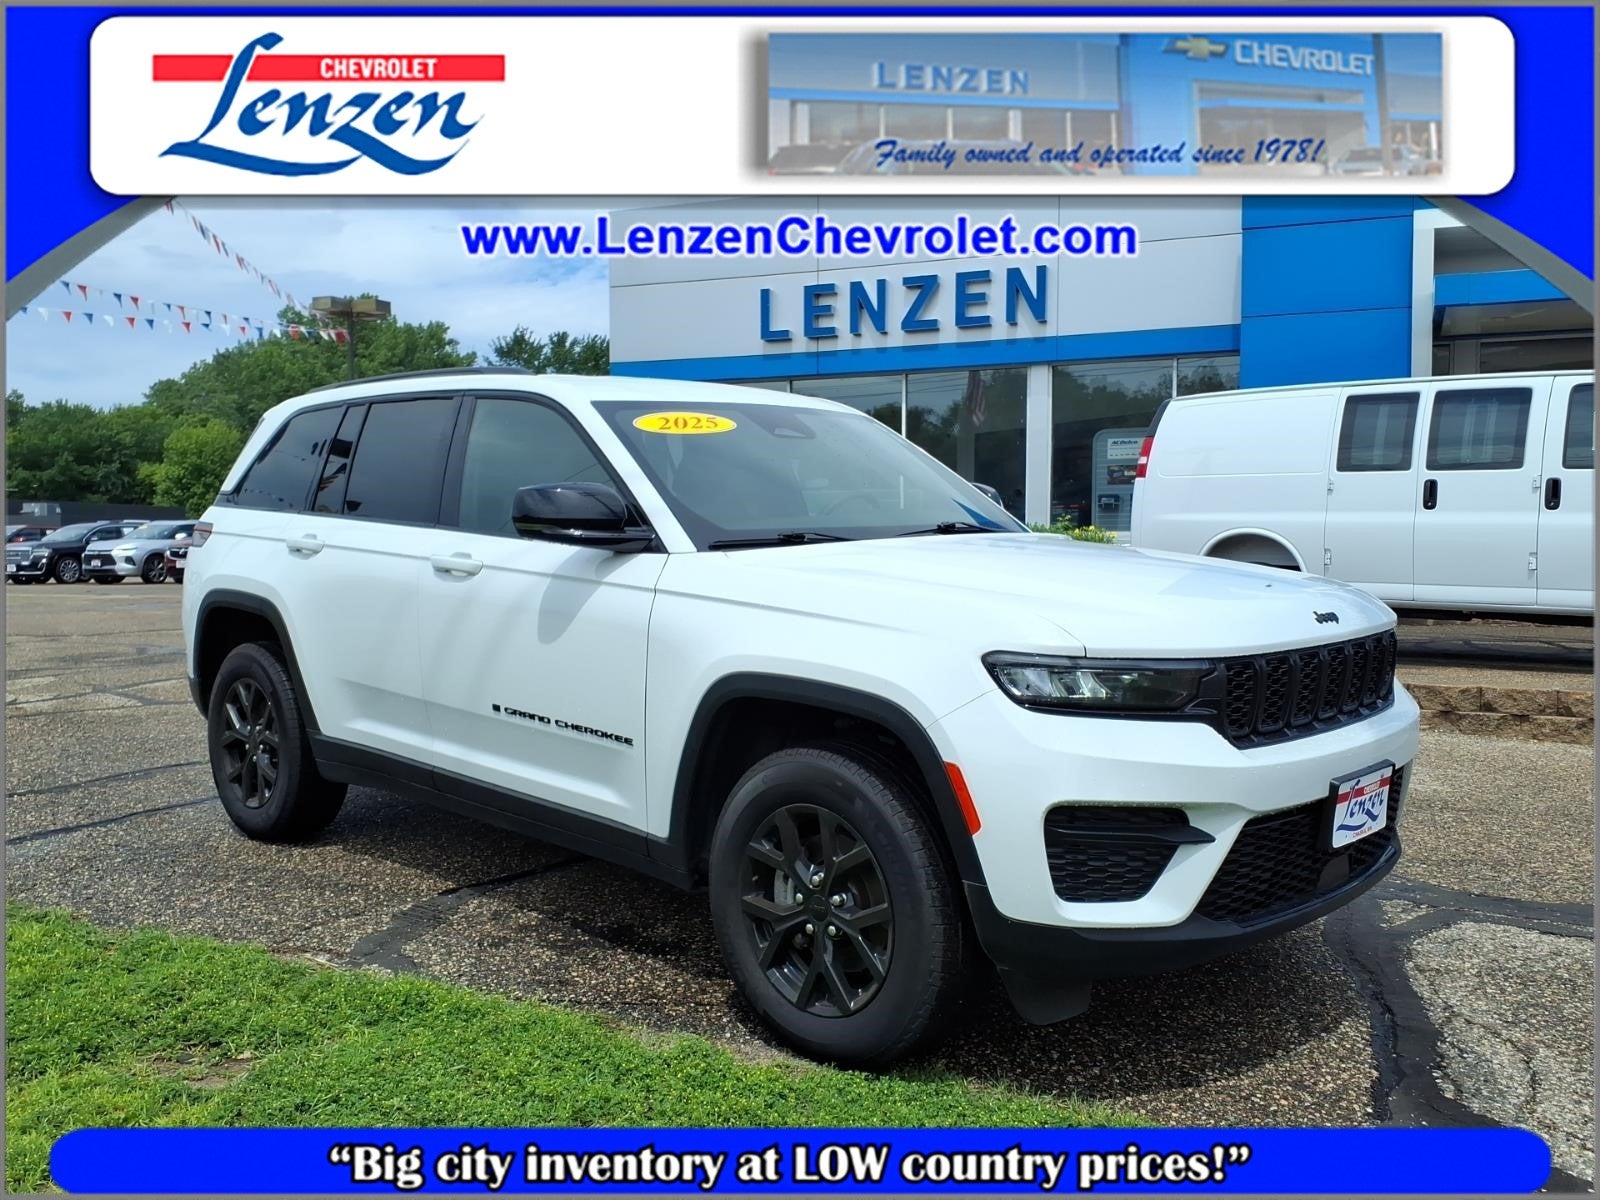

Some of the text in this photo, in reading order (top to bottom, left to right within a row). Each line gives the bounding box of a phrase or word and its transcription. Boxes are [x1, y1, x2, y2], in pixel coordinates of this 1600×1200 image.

[760, 264, 1048, 342] LENZEN
[658, 415, 719, 431] 2025
[503, 706, 634, 746] GRAND CHEROKEE
[1335, 778, 1385, 832] Lenzen
